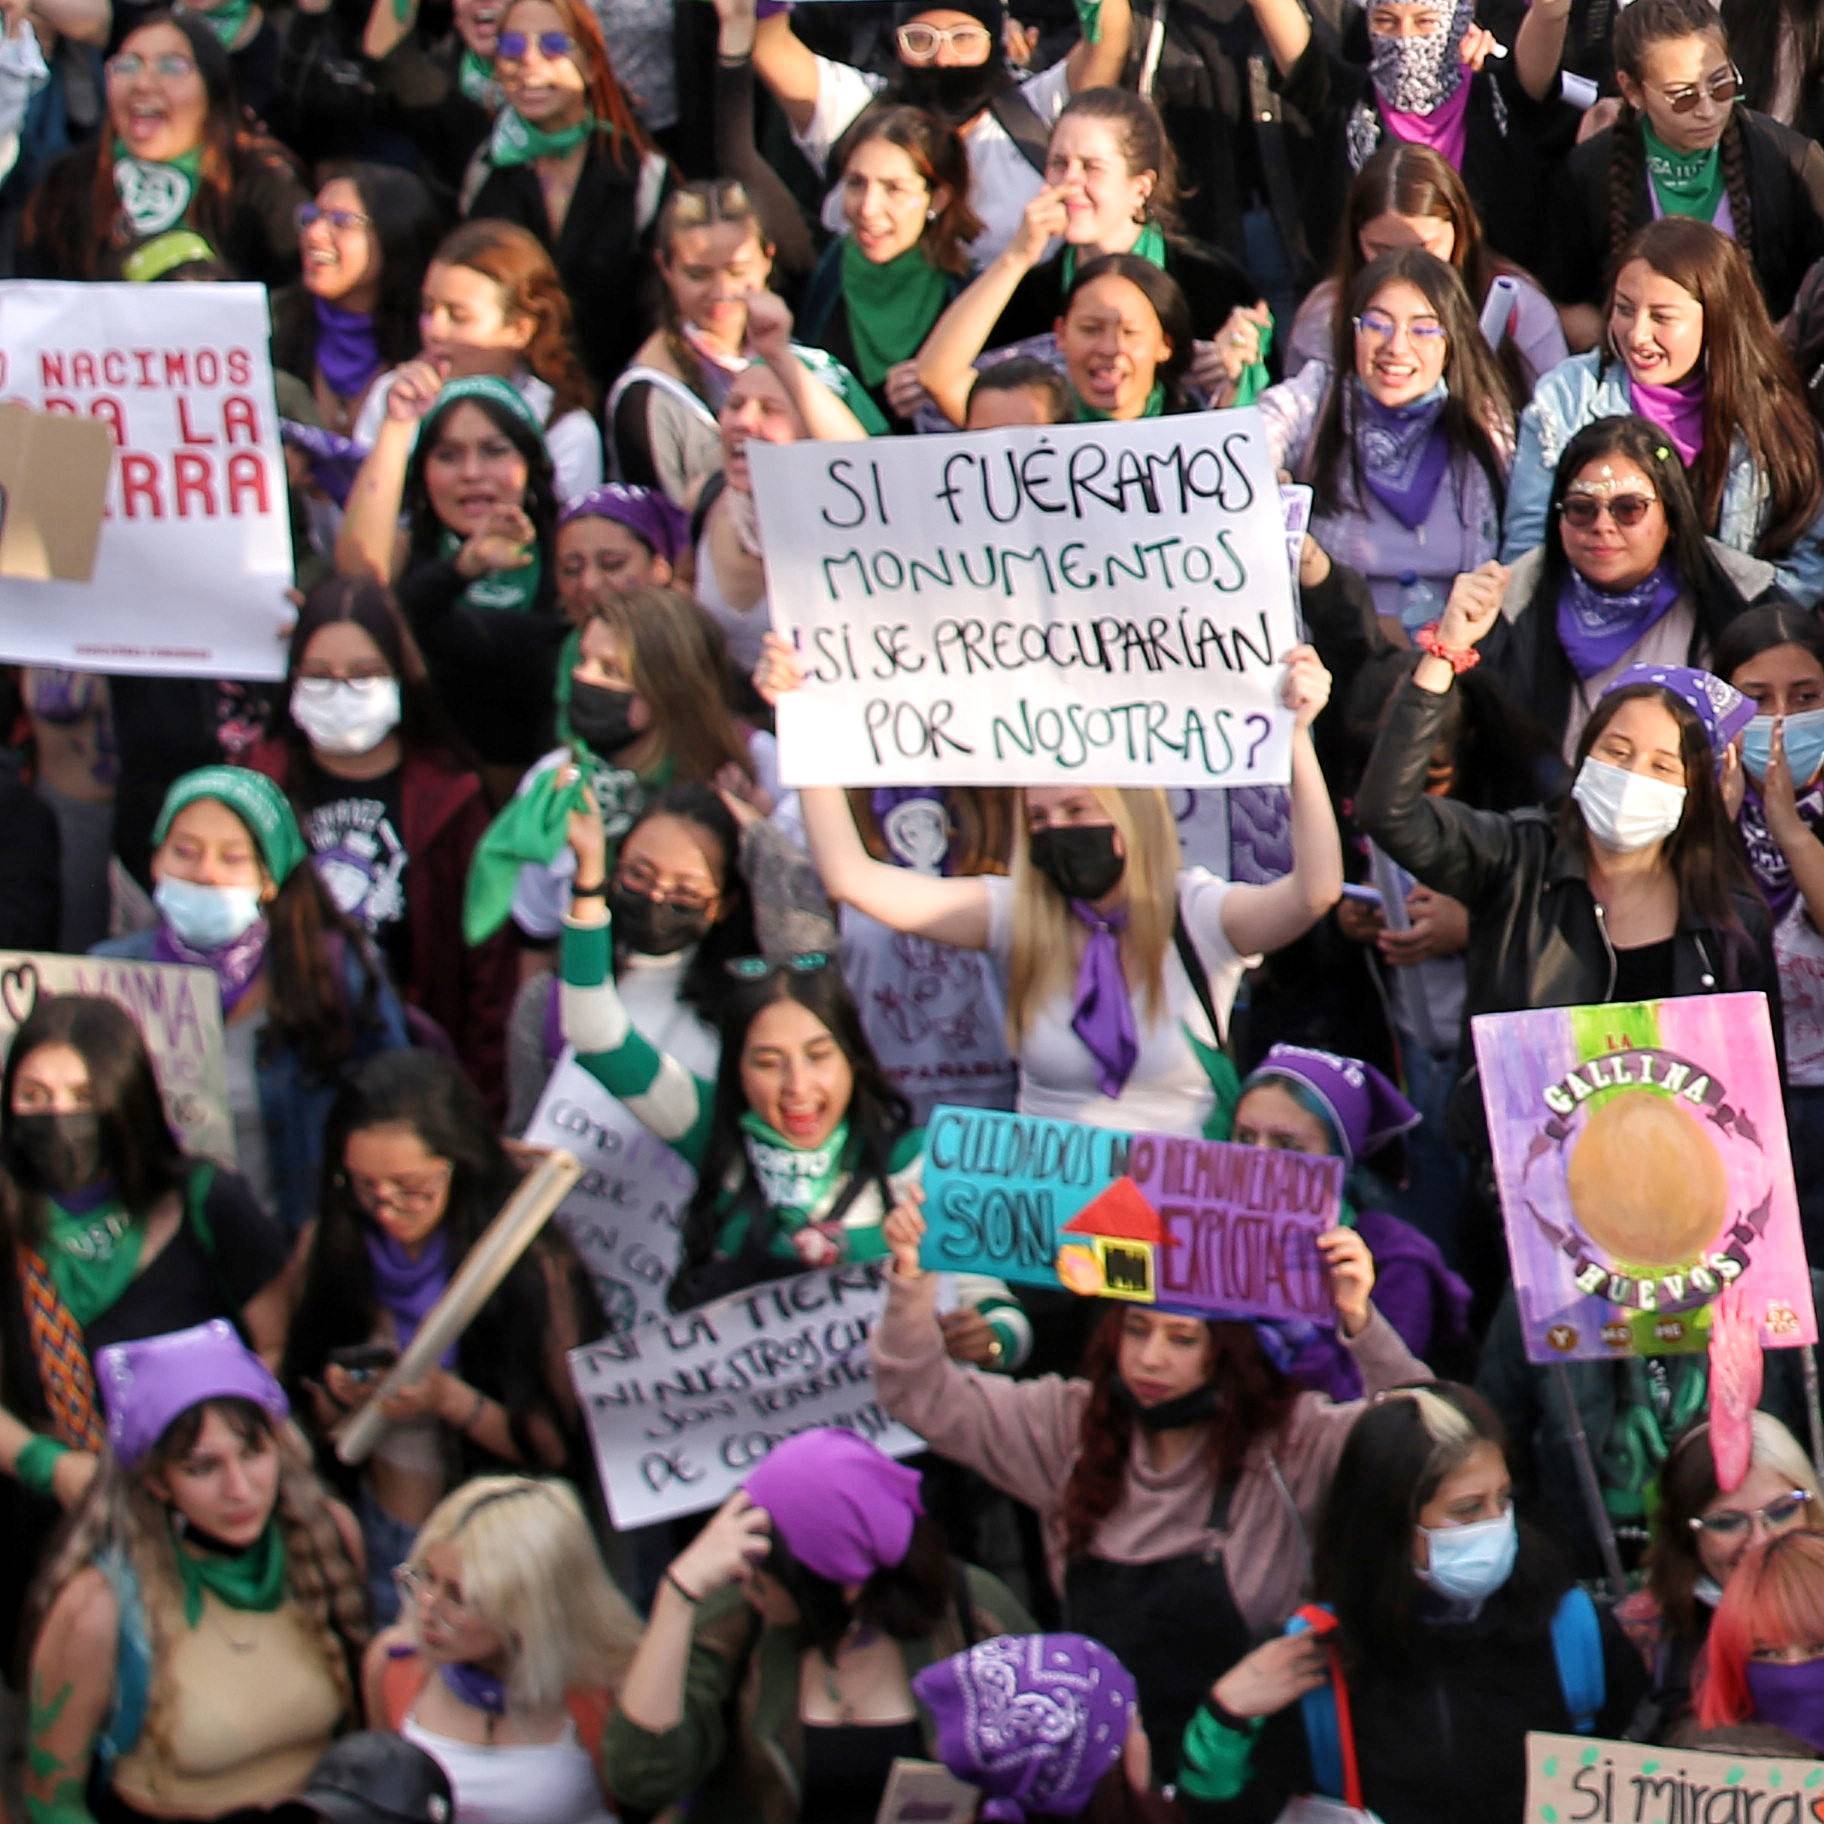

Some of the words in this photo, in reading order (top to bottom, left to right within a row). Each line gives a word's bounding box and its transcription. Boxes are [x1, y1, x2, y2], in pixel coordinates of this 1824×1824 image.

[40, 347, 253, 392] NACIMOS
[175, 398, 263, 446] LA
[822, 458, 892, 530] SI
[822, 529, 1245, 601] MONUMENTOS
[871, 622, 931, 679] SE
[936, 611, 1277, 677] PREOCUPARÍAN
[864, 697, 974, 767] POR
[991, 695, 1274, 777] NOSOTRAS?
[942, 1184, 1055, 1268] SON
